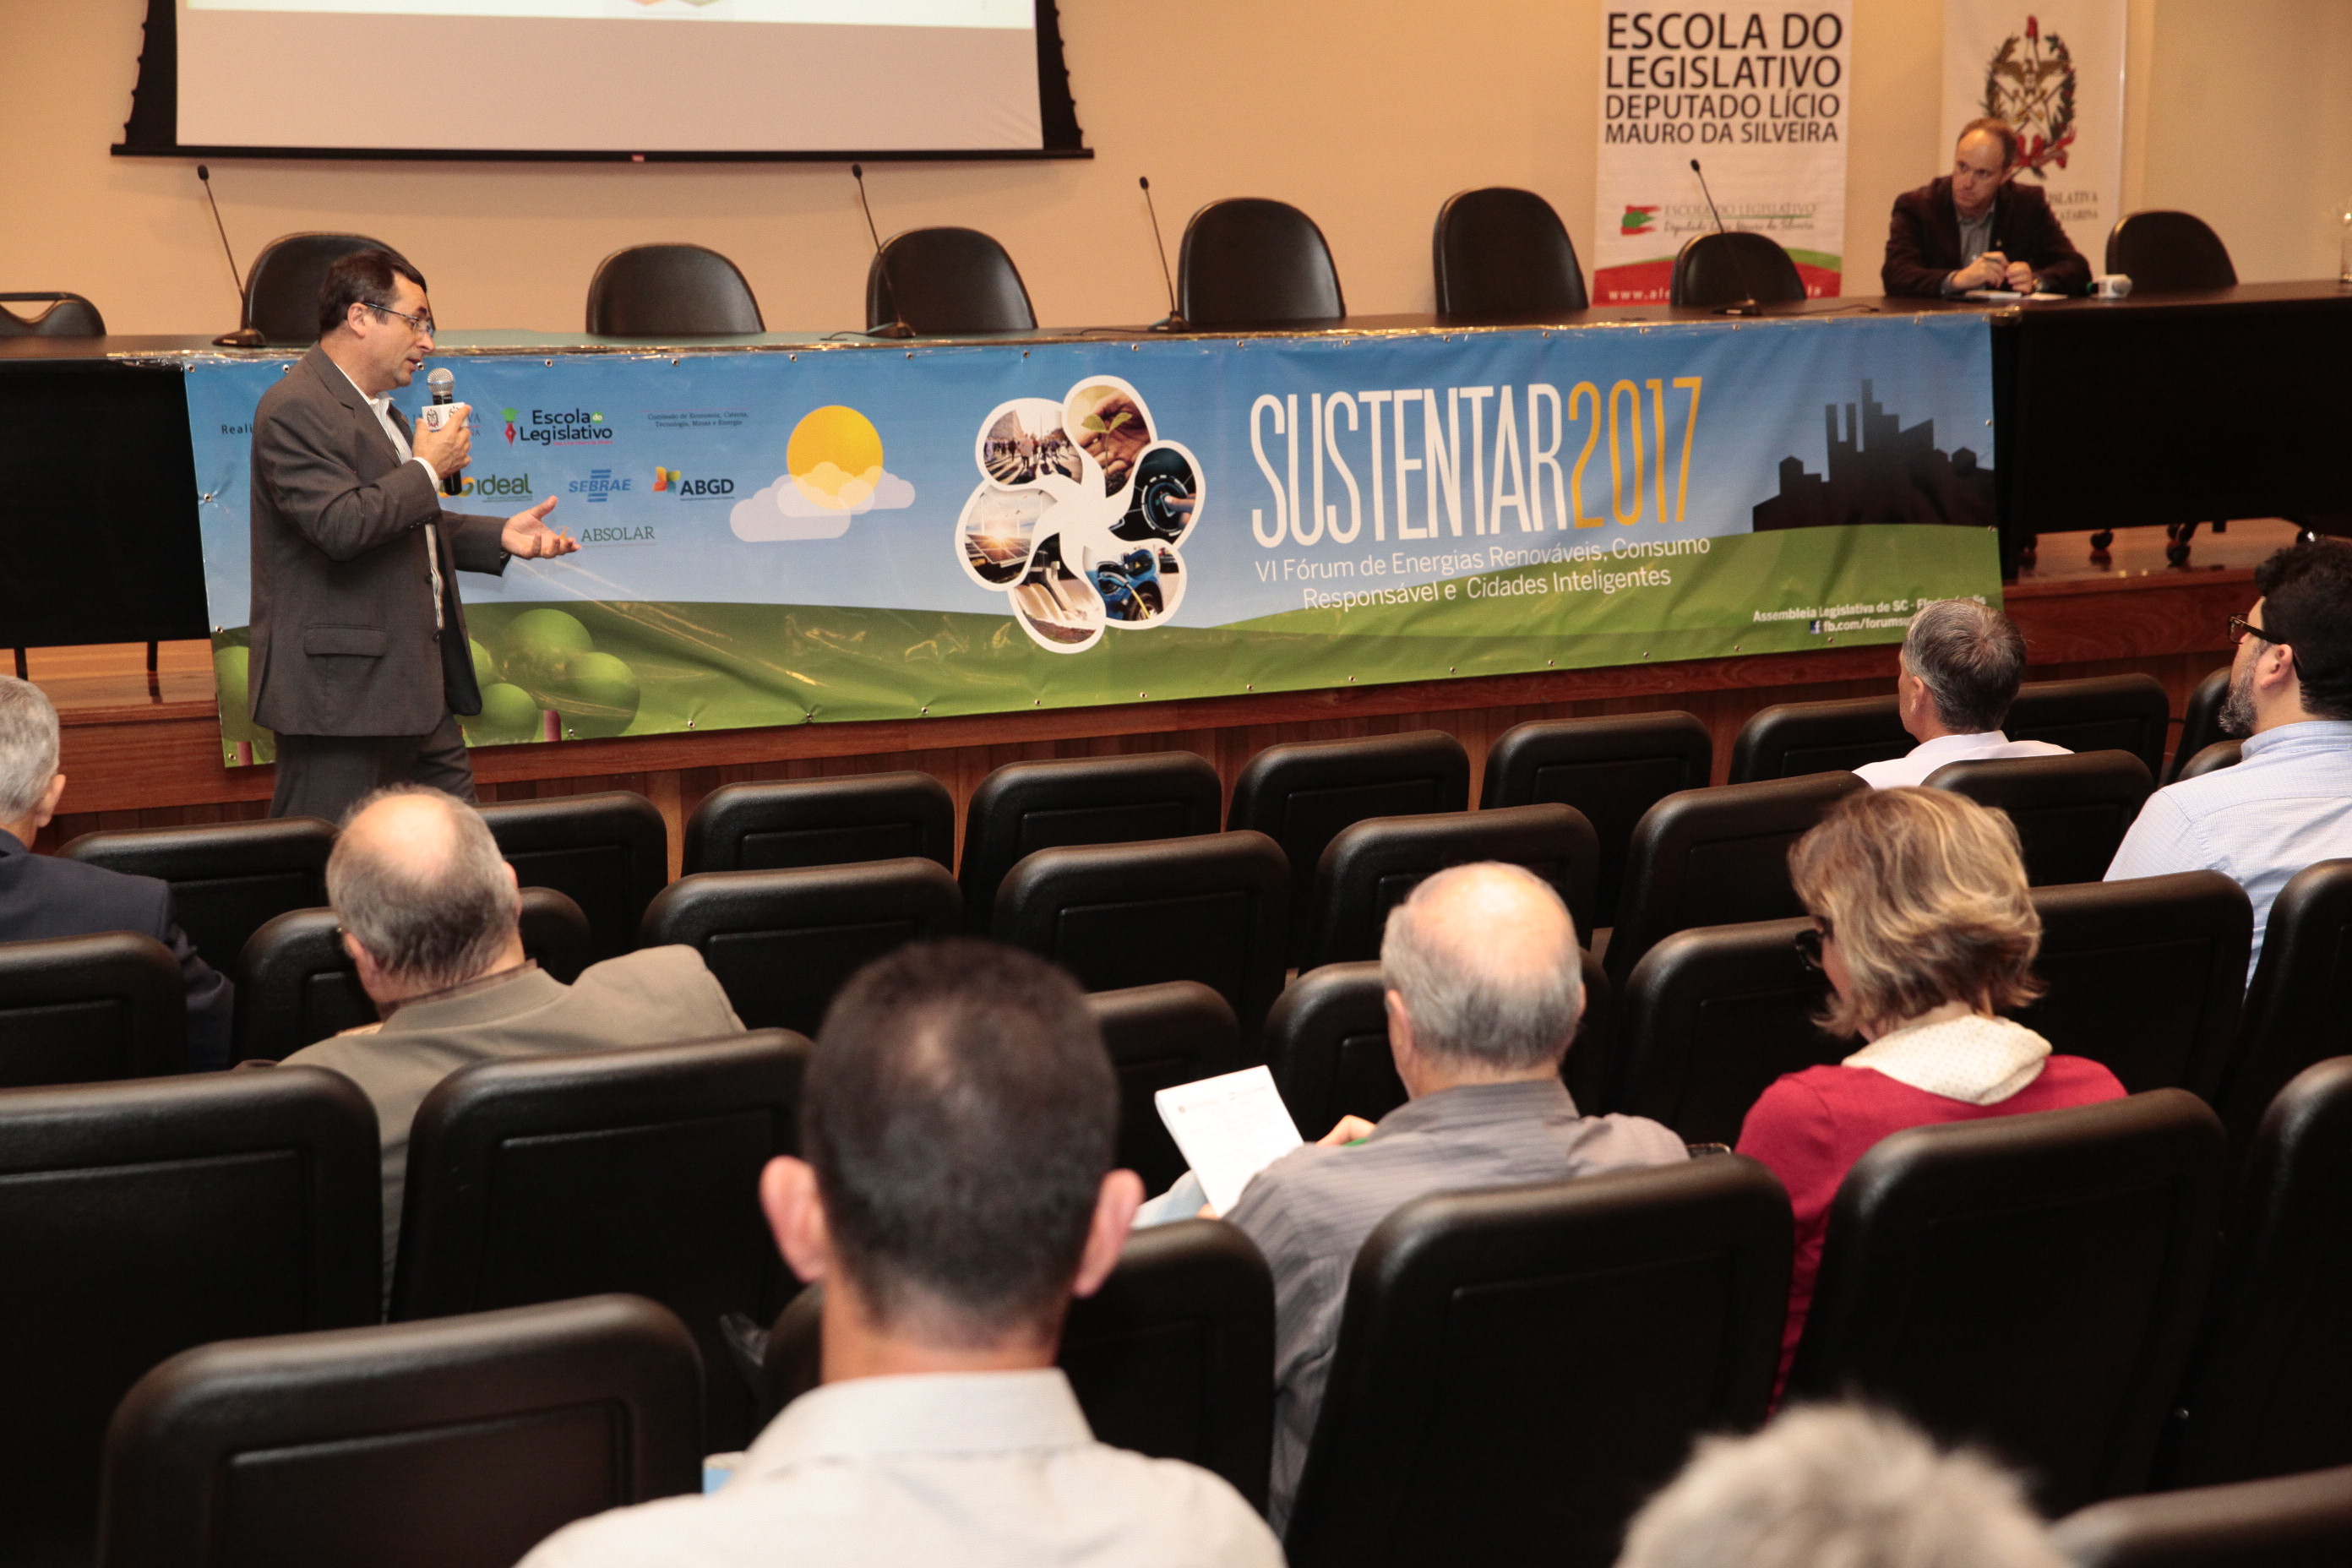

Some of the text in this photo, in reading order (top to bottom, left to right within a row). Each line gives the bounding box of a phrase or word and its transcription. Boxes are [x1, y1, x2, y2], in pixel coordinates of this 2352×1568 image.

[1608, 13, 1843, 50] ESCOLA DO
[1607, 56, 1841, 88] LEGISLATIVO
[1606, 88, 1840, 119] DEPUTADO LÍCIO
[1606, 122, 1838, 144] MAURO DA SILVEIRA
[532, 408, 591, 424] Escola
[520, 424, 612, 445] Legislativo
[476, 473, 533, 495] ideal
[569, 479, 631, 493] SEBRAE
[680, 479, 734, 496] ABGD
[581, 526, 655, 542] ABSOLAR
[1255, 537, 1711, 582] VI Fórum de Energias Renováveis, Consumo
[1304, 566, 1672, 612] Responsável e Cidades Inteligentes
[1753, 607, 1817, 622] Assembleia
[1819, 603, 1874, 618] Legislativa
[1876, 601, 1890, 613] de
[1892, 599, 1909, 612] SC
